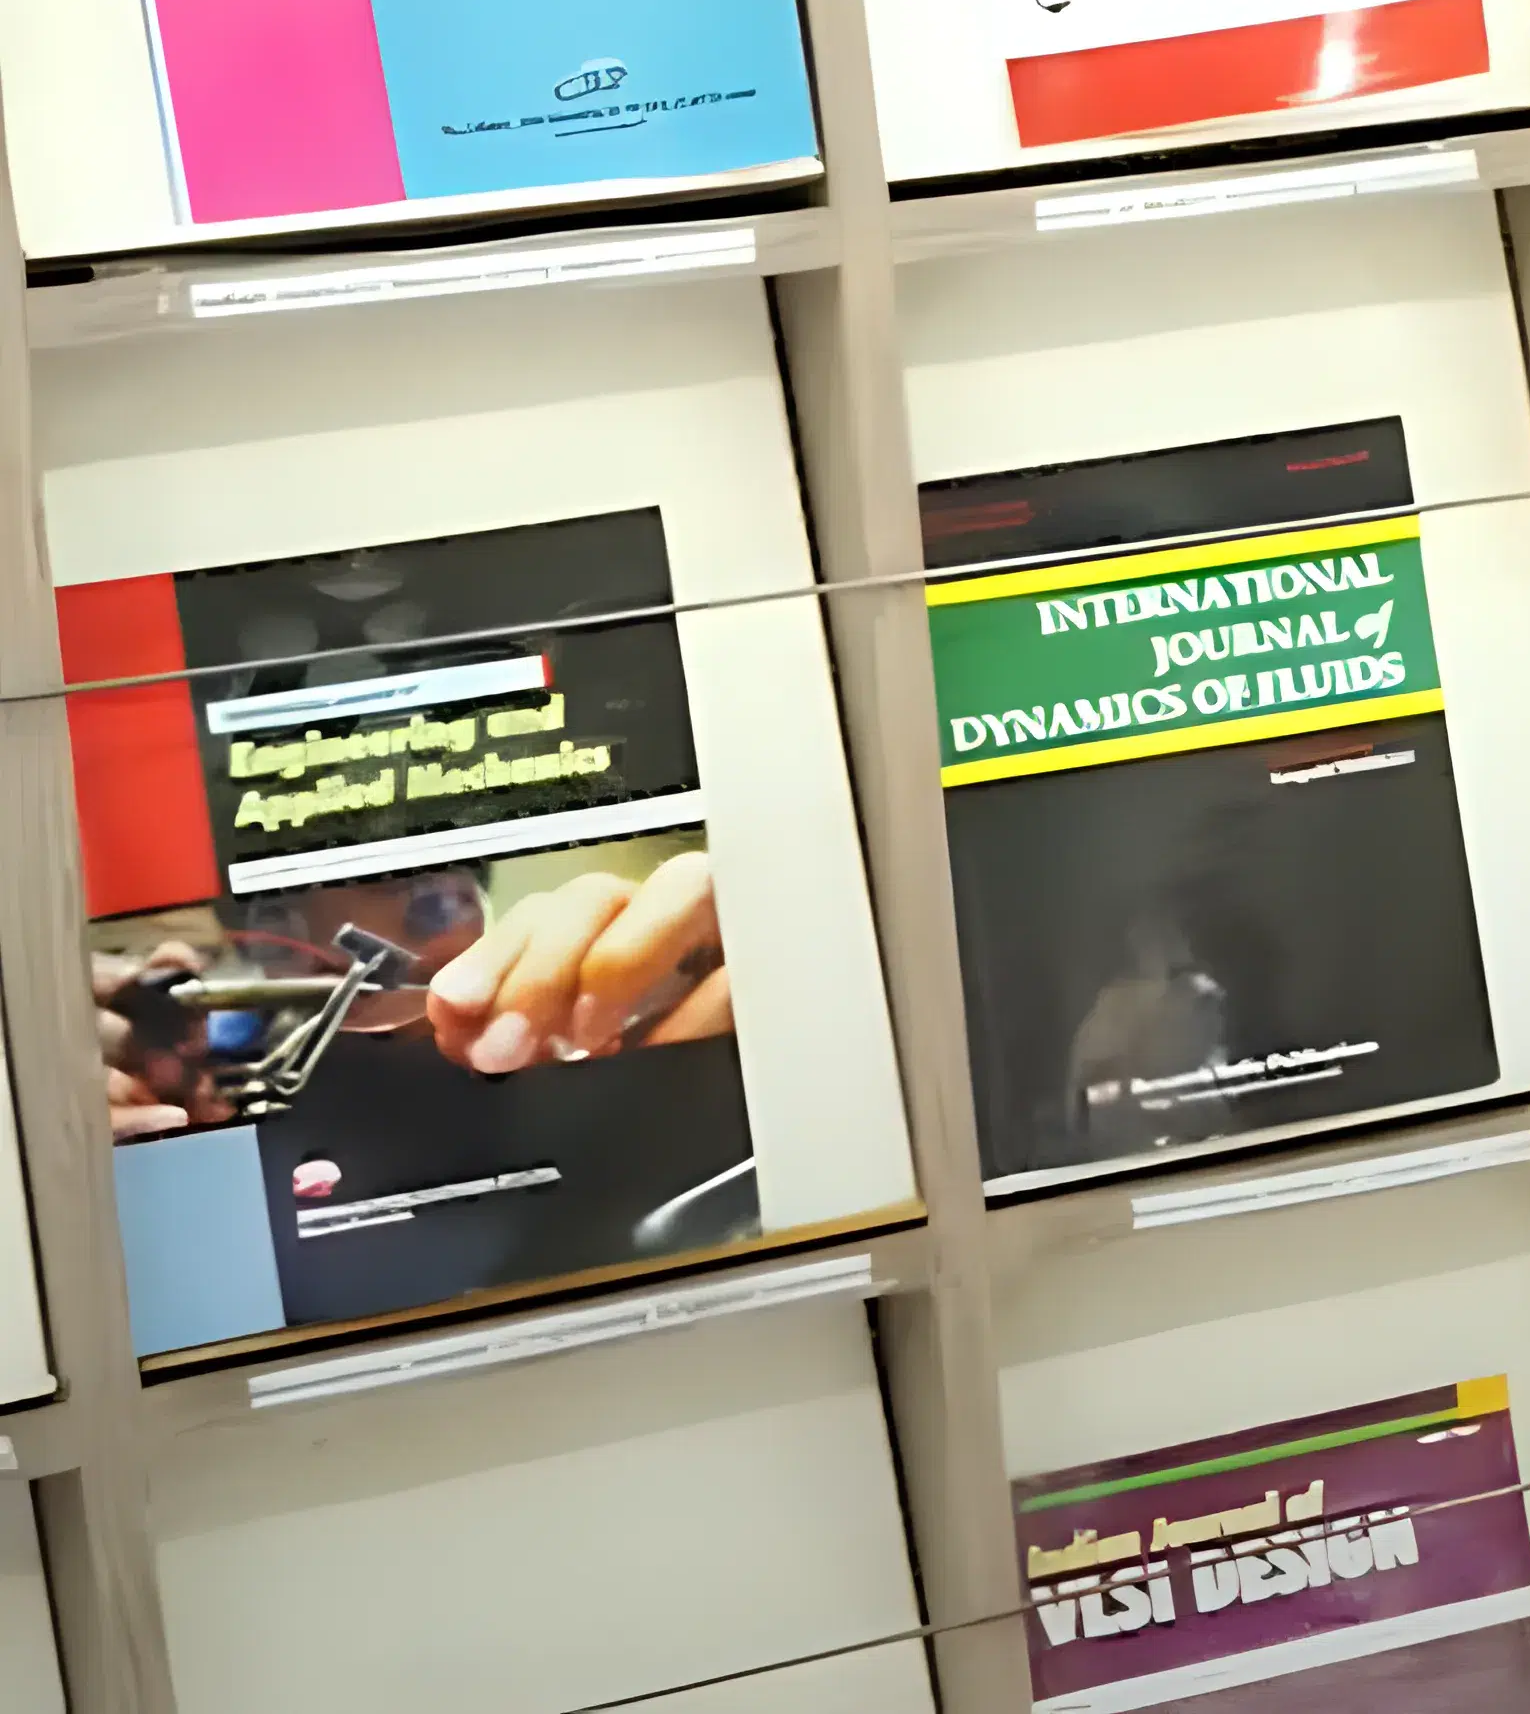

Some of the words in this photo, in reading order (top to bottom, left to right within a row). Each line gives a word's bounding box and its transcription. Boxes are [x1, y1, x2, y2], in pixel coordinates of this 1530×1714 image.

[1037, 550, 1396, 638] INTERNATIONAL
[1152, 610, 1351, 678] JOURNAL
[949, 682, 1189, 755] DYNAMICS
[1200, 673, 1252, 719] OF
[1251, 649, 1408, 710] FLUIDS
[1190, 1503, 1420, 1614] DESIGN
